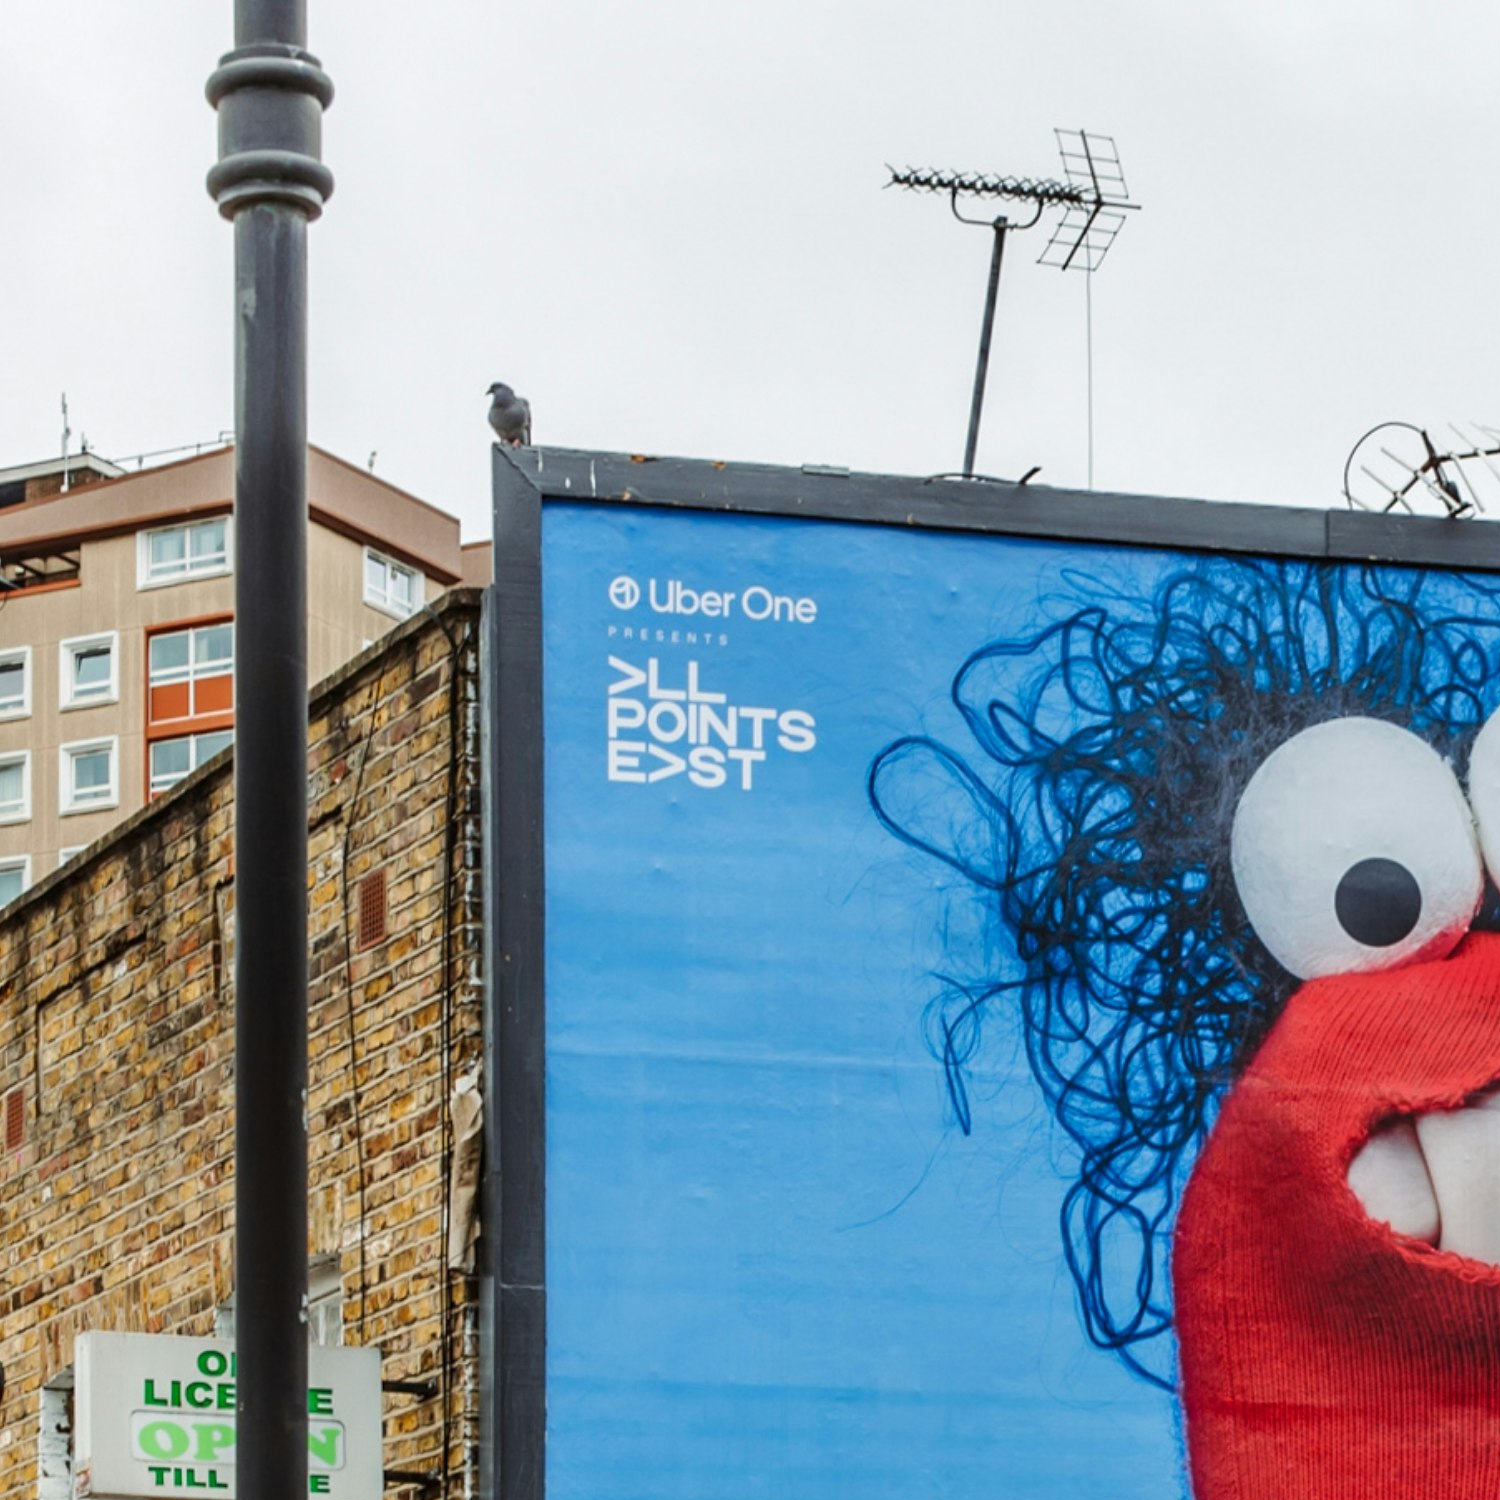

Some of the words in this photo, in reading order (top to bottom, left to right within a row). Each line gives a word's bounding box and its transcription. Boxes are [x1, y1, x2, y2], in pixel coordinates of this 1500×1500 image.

[648, 577, 735, 618] Uber
[741, 586, 818, 625] One
[607, 625, 730, 647] PRESENTS
[607, 698, 818, 753] POINTS
[144, 1379, 333, 1415] LICEE
[138, 1421, 341, 1467] OPN
[148, 1466, 229, 1489] TILL
